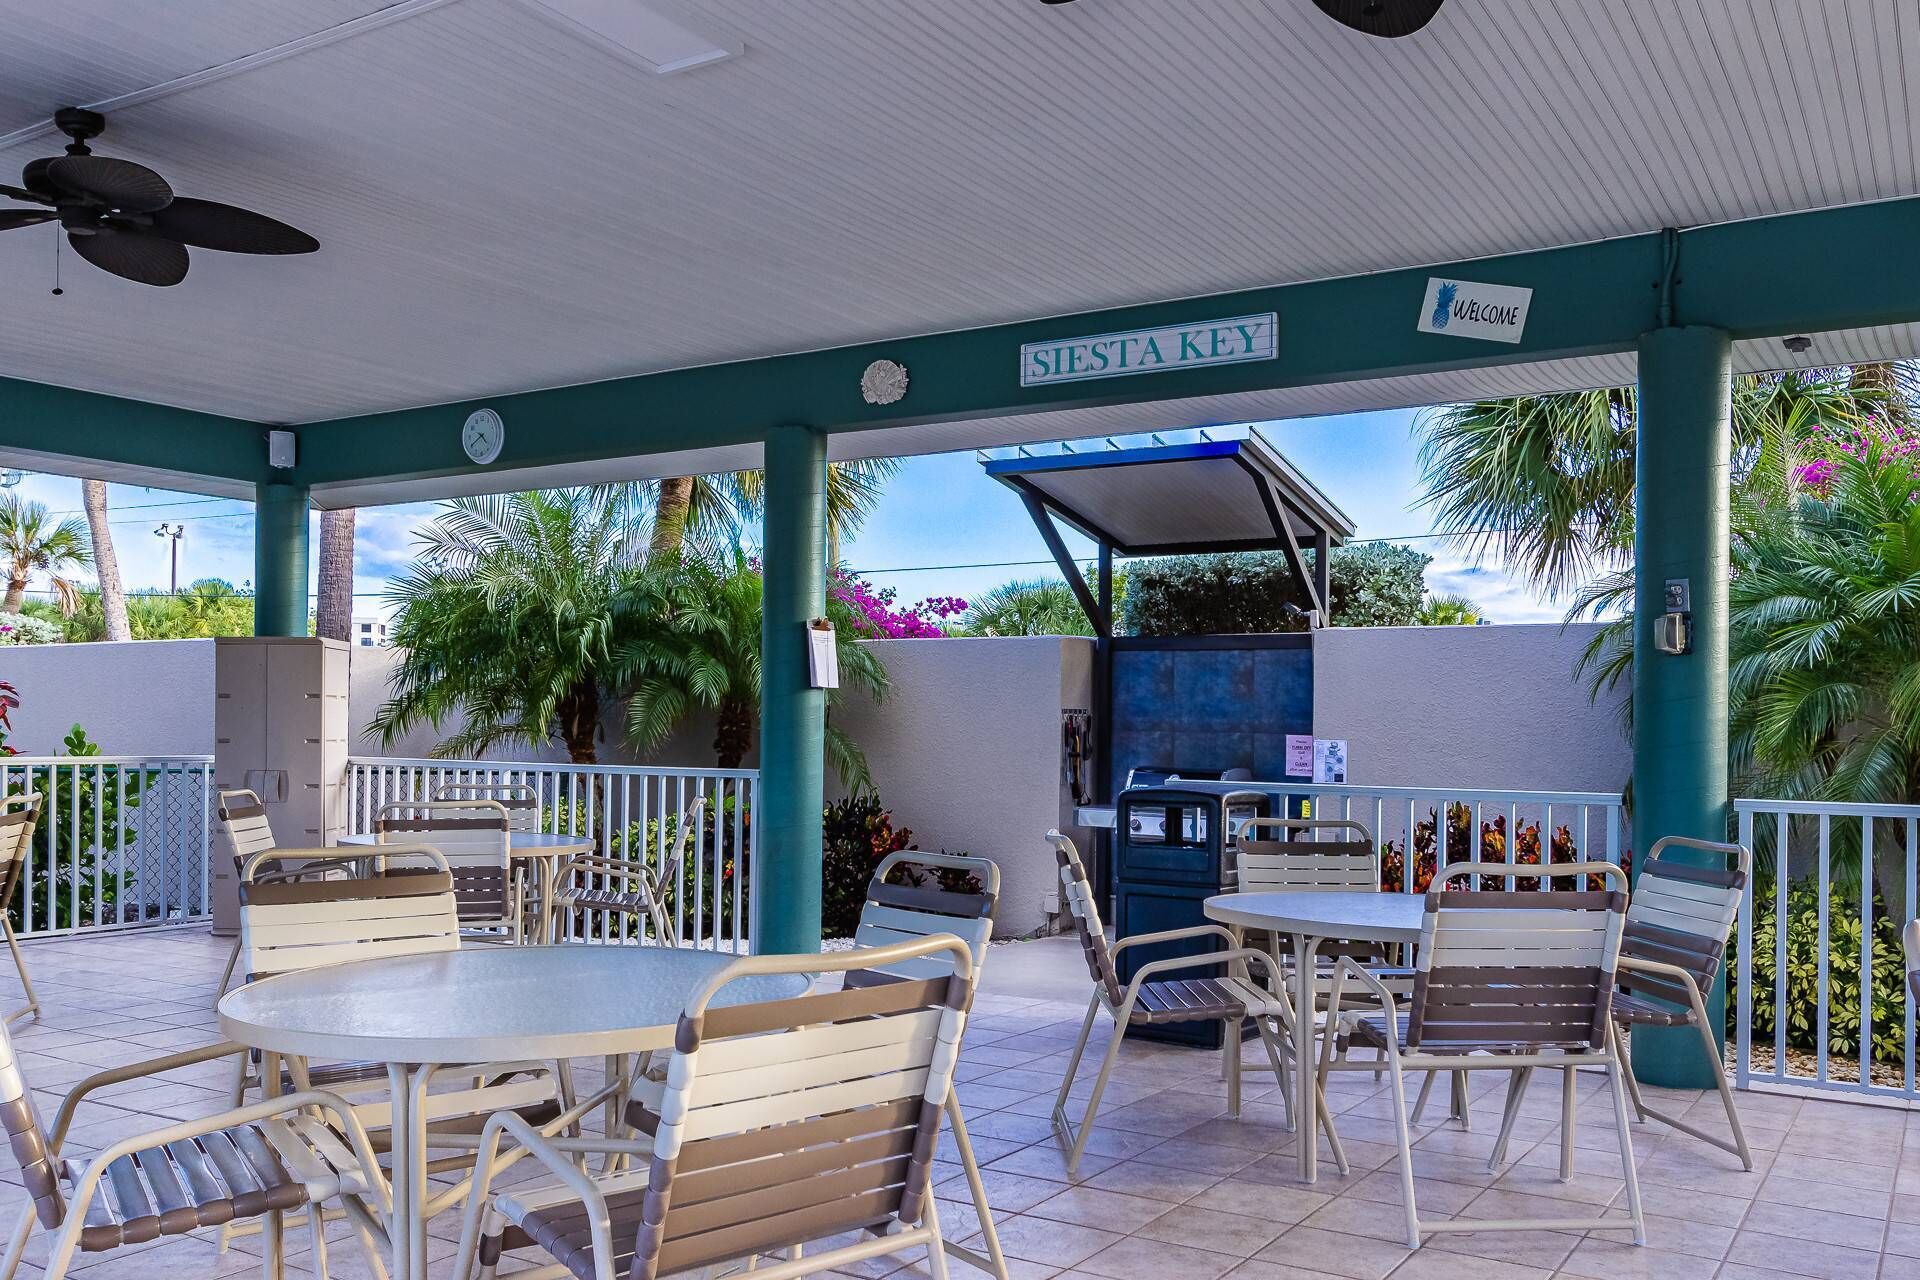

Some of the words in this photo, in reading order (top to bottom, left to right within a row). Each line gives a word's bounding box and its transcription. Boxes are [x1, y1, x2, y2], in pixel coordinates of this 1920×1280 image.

[1453, 299, 1519, 325] WELCOME
[1031, 335, 1165, 378] SIESTA
[1178, 323, 1263, 361] KEY
